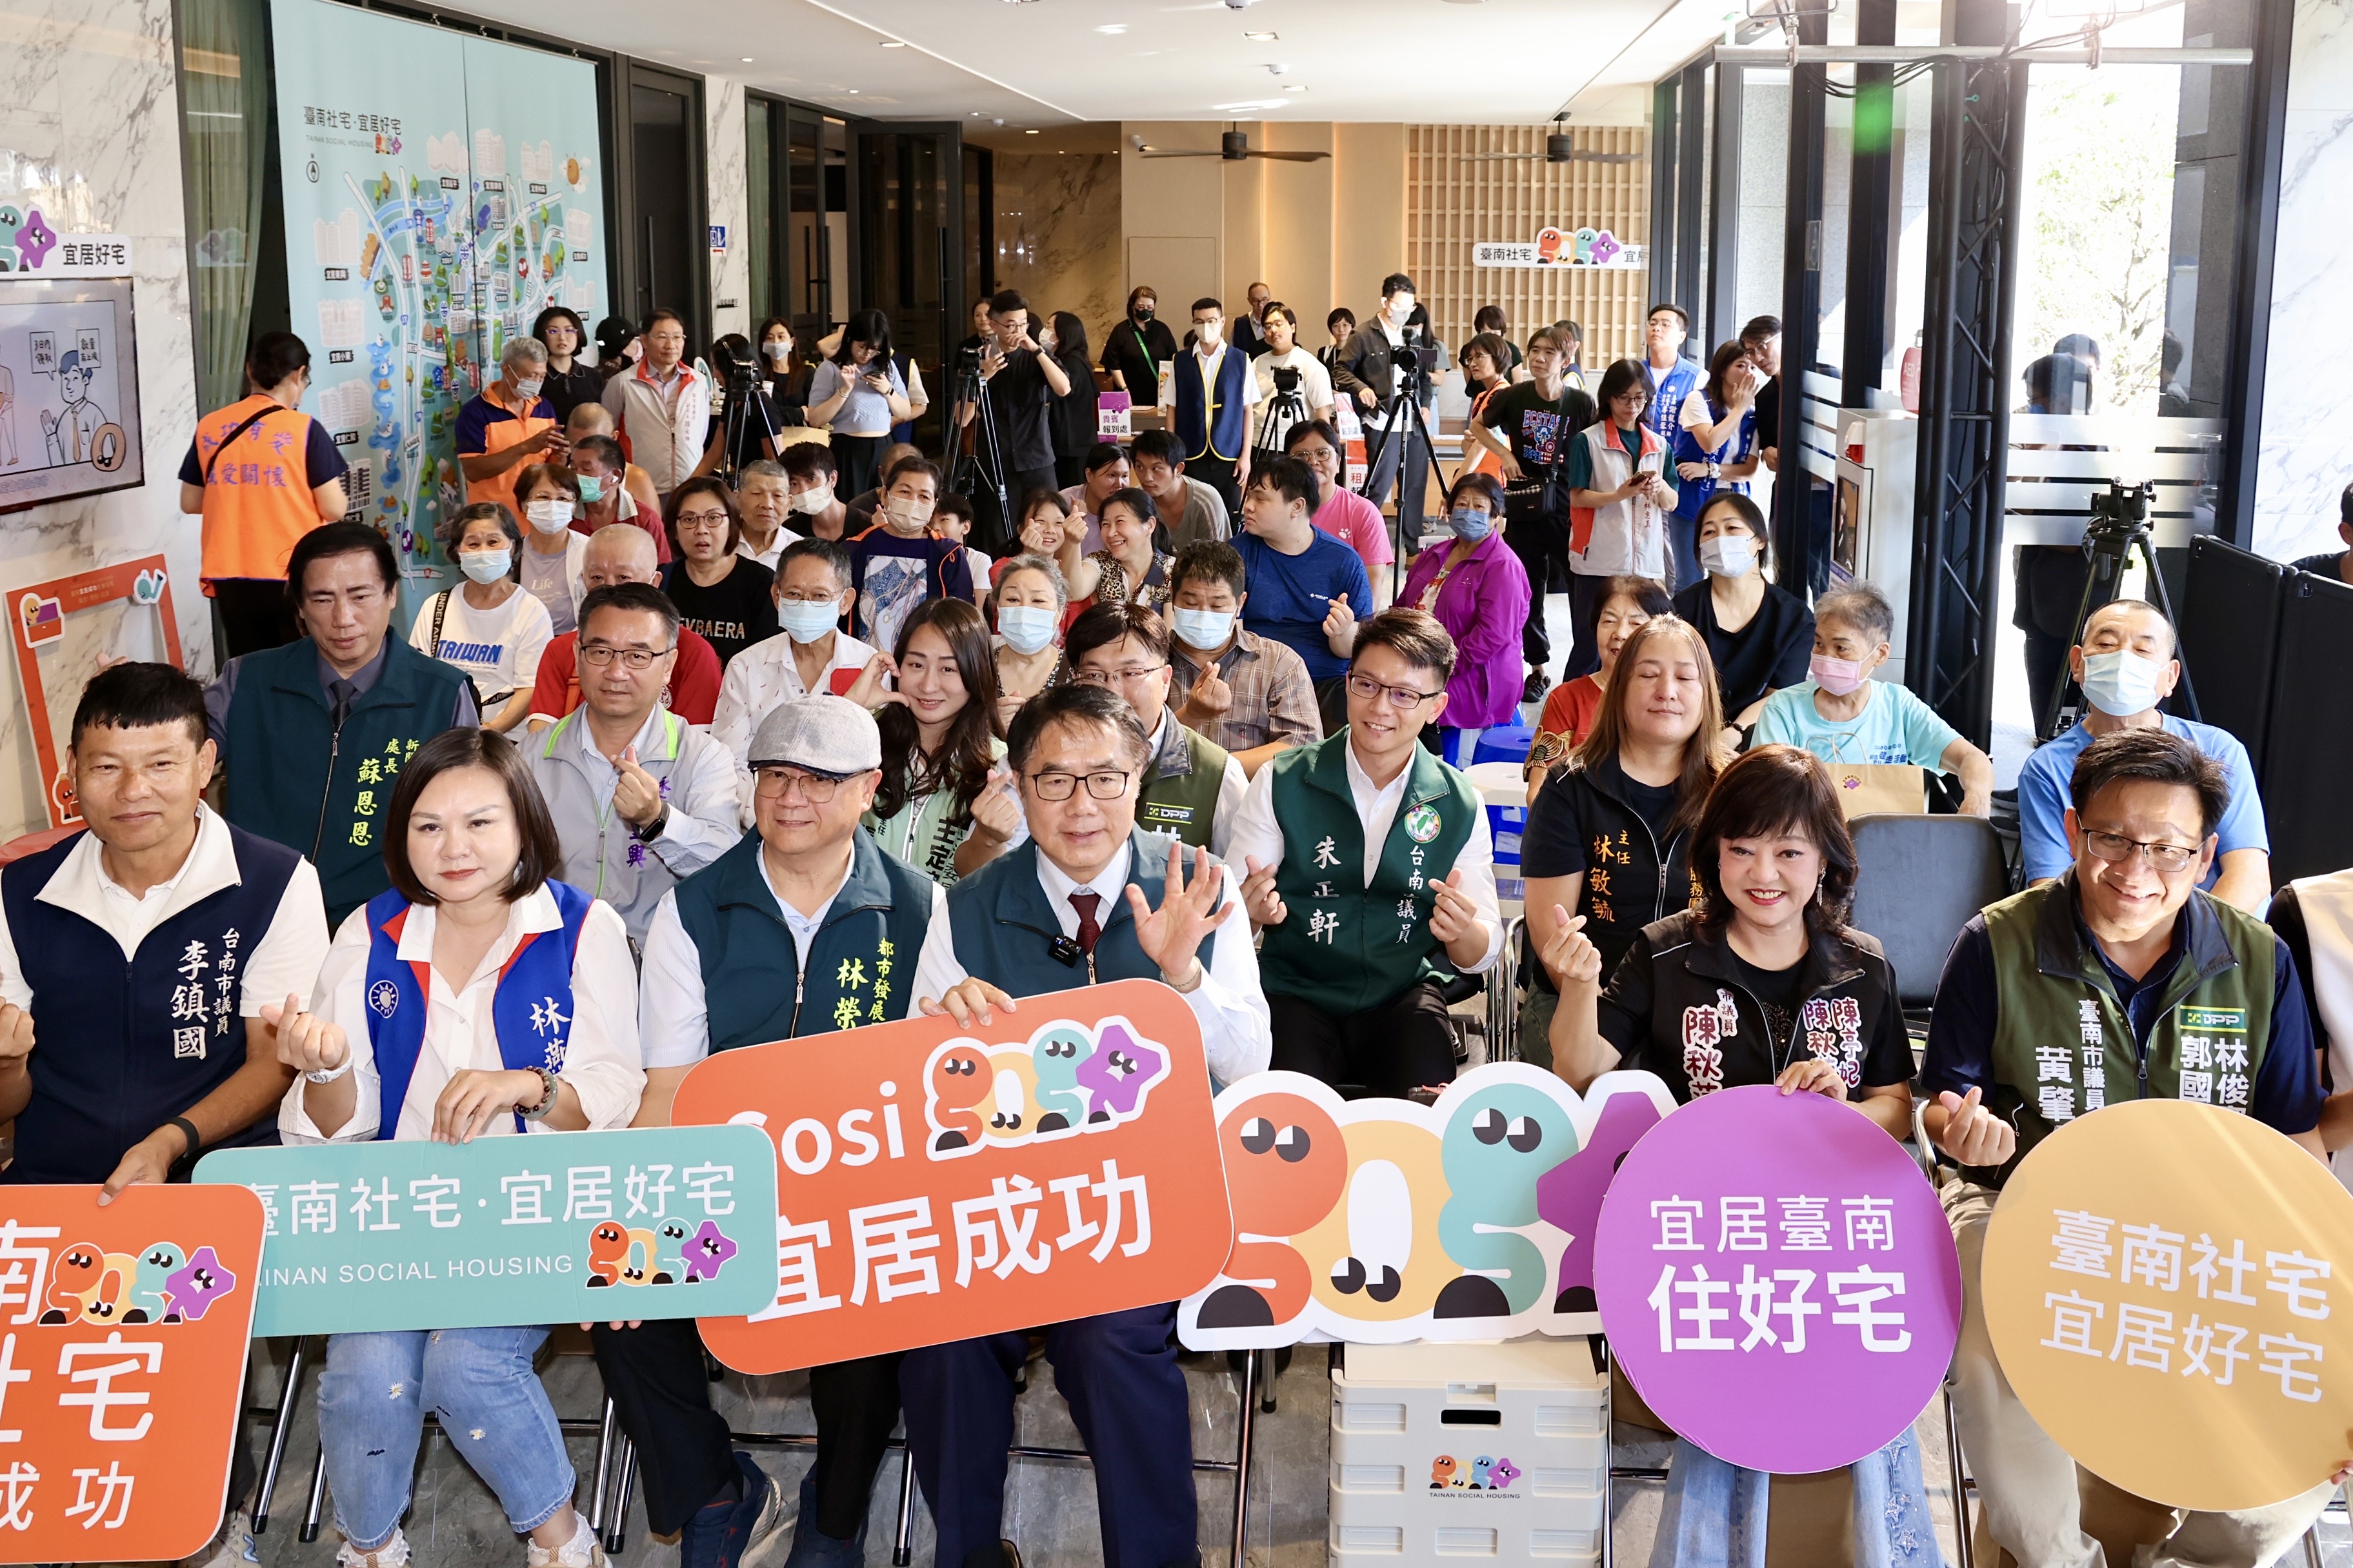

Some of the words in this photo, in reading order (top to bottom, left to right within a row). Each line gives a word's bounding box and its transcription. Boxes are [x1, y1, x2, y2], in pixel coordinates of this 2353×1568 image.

[303, 106, 401, 135] 臺南社宅·宜居好宅
[325, 137, 346, 145] SOCIAL
[348, 139, 373, 148] HOUSING
[63, 243, 125, 266] 宜居好宅
[1480, 248, 1532, 261] 臺南社宅
[1103, 425, 1128, 433] 報到處
[434, 592, 448, 625] UNDER
[531, 578, 554, 591] Life
[437, 639, 504, 666] TAIWAN
[384, 738, 401, 773] 處長
[349, 758, 383, 846] 蘇恩恩
[1160, 808, 1190, 819] DPP
[1616, 829, 1631, 864] 主任
[1307, 835, 1342, 945] 朱正軒
[1396, 845, 1425, 944] 台南議員
[170, 940, 210, 1060] 李鎮國
[213, 928, 240, 1037] 台南市議員
[868, 937, 894, 1025] 都市發展
[1721, 991, 1734, 1033] 市議員
[2203, 1013, 2239, 1025] DPP
[2078, 999, 2106, 1110] 臺南市議員
[2215, 1038, 2250, 1114] 林俊
[727, 1080, 905, 1176] osi
[747, 1159, 1152, 1323] 宜居成功
[1650, 1194, 1895, 1253] 宜居臺南
[259, 1265, 326, 1287] INAN
[339, 1262, 437, 1283] SOCIAL
[448, 1255, 572, 1277] HOUSING
[2049, 1209, 2331, 1320] 臺南社宅
[1648, 1264, 1912, 1354] 住好宅
[2040, 1289, 2323, 1403] 宜居好宅
